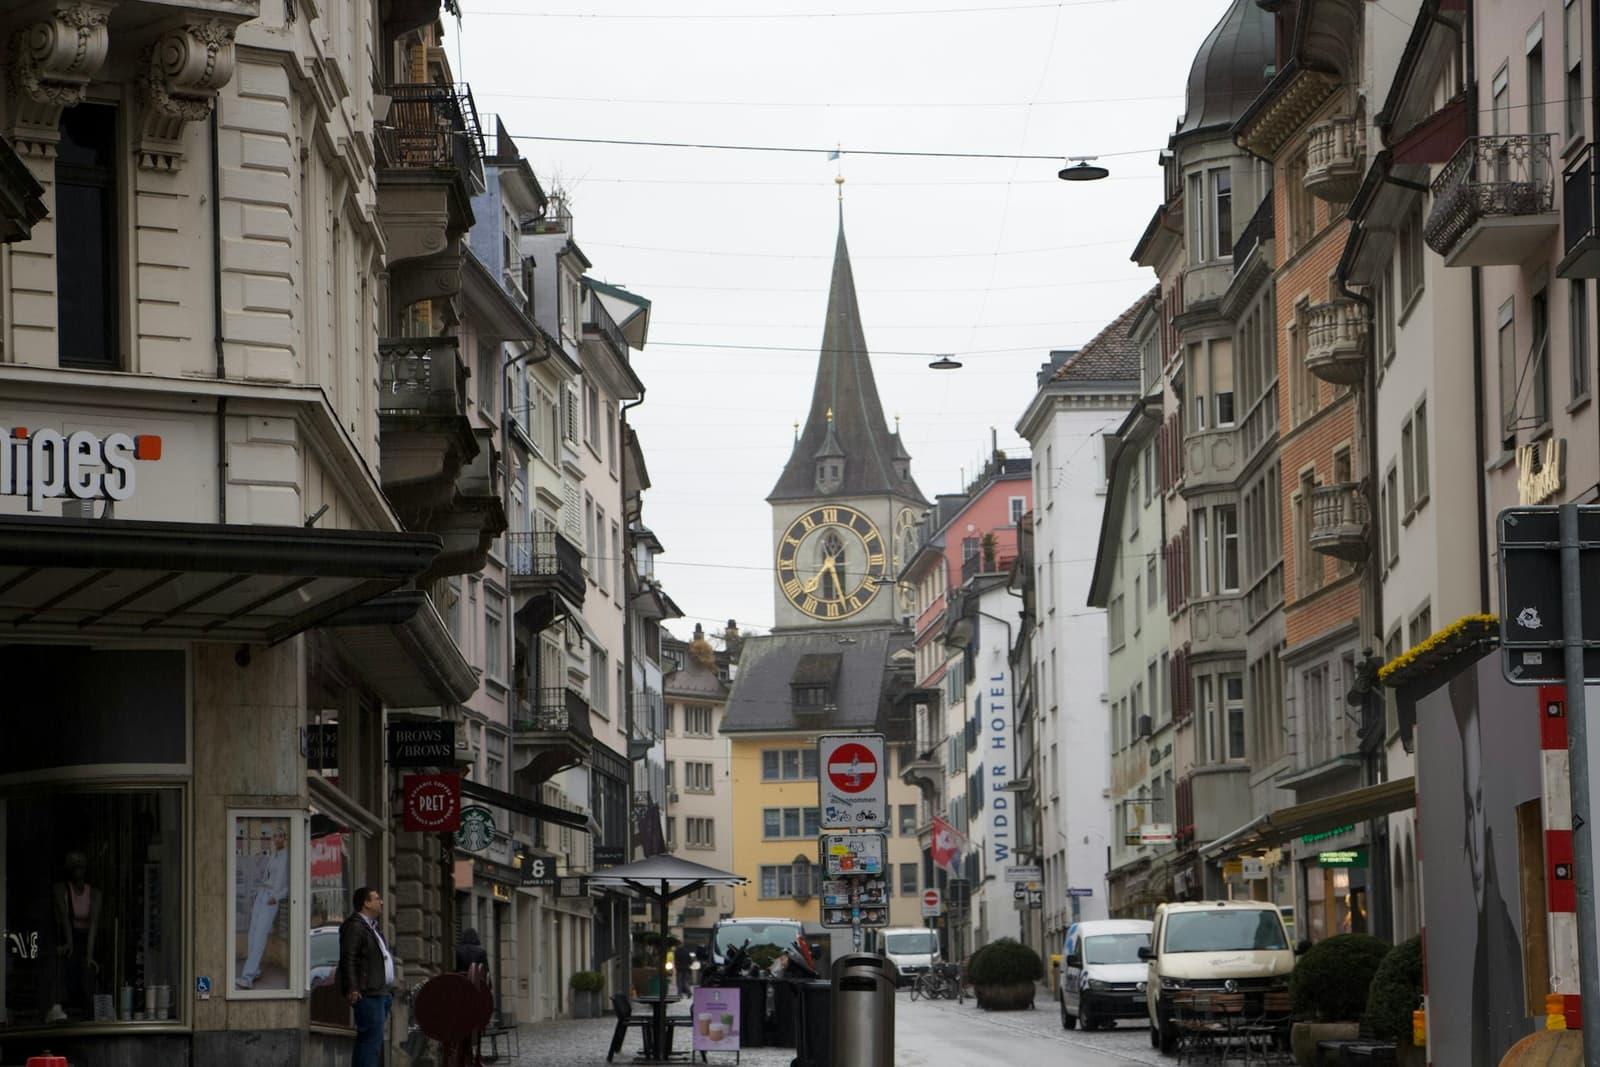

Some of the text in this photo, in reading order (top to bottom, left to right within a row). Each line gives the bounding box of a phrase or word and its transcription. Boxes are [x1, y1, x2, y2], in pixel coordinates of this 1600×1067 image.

[396, 730, 442, 742] BROWS
[990, 671, 1009, 862] WIDDER HOTEL
[419, 794, 445, 812] PRET
[532, 859, 545, 878] &
